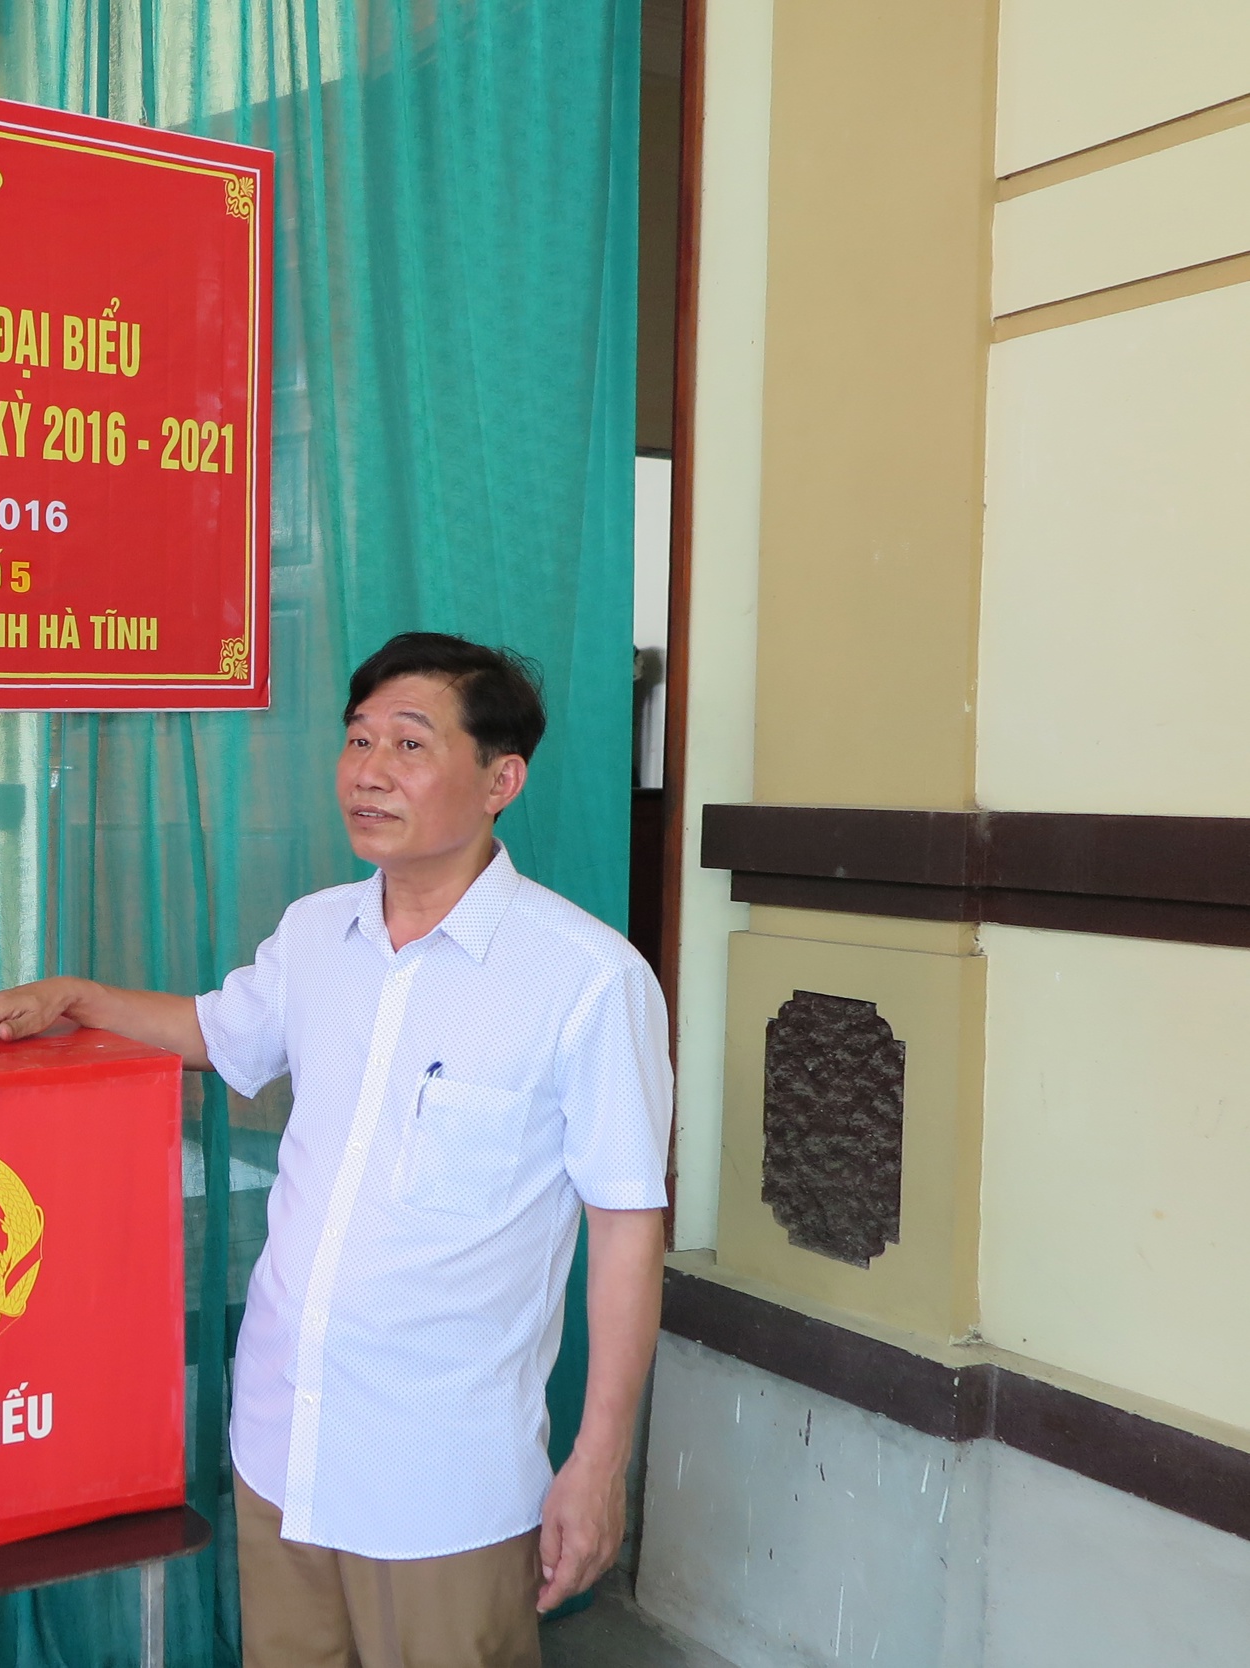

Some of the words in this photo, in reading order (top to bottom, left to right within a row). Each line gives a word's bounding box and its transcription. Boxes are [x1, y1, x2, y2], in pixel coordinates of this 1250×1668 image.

[62, 296, 141, 378] BIỂU
[42, 405, 126, 466] 2016
[137, 439, 150, 451] -
[160, 416, 234, 475] 2021
[10, 560, 31, 593] 5
[39, 607, 81, 649] HÀ
[89, 608, 158, 651] TĨNH
